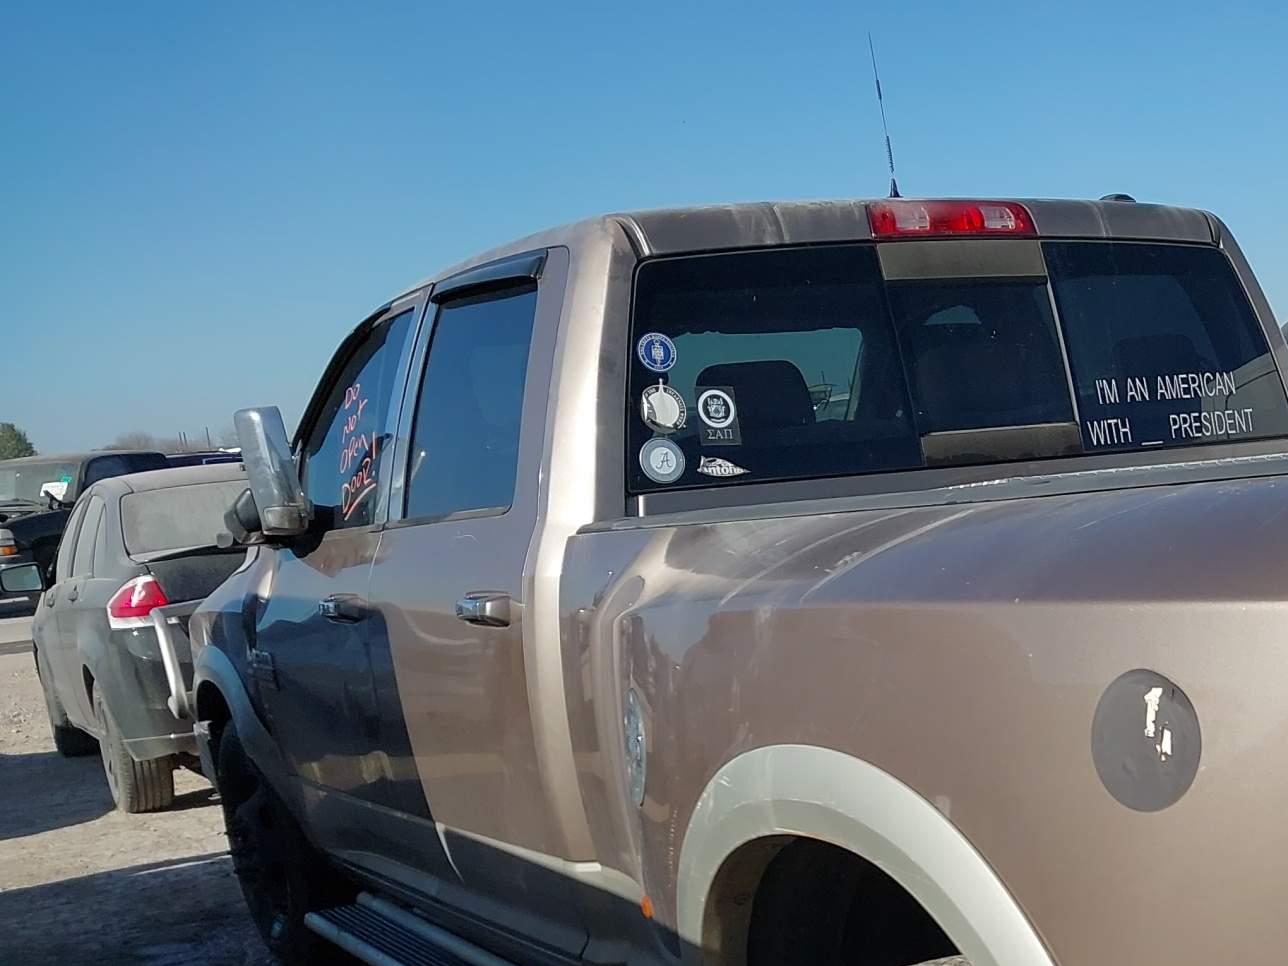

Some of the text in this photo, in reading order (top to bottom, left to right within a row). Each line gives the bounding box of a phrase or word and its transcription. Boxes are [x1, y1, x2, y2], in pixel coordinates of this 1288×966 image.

[1095, 371, 1236, 405] I'M AN AMERICAN
[1087, 417, 1132, 446] WITH
[1169, 408, 1253, 439] PRESIDENT
